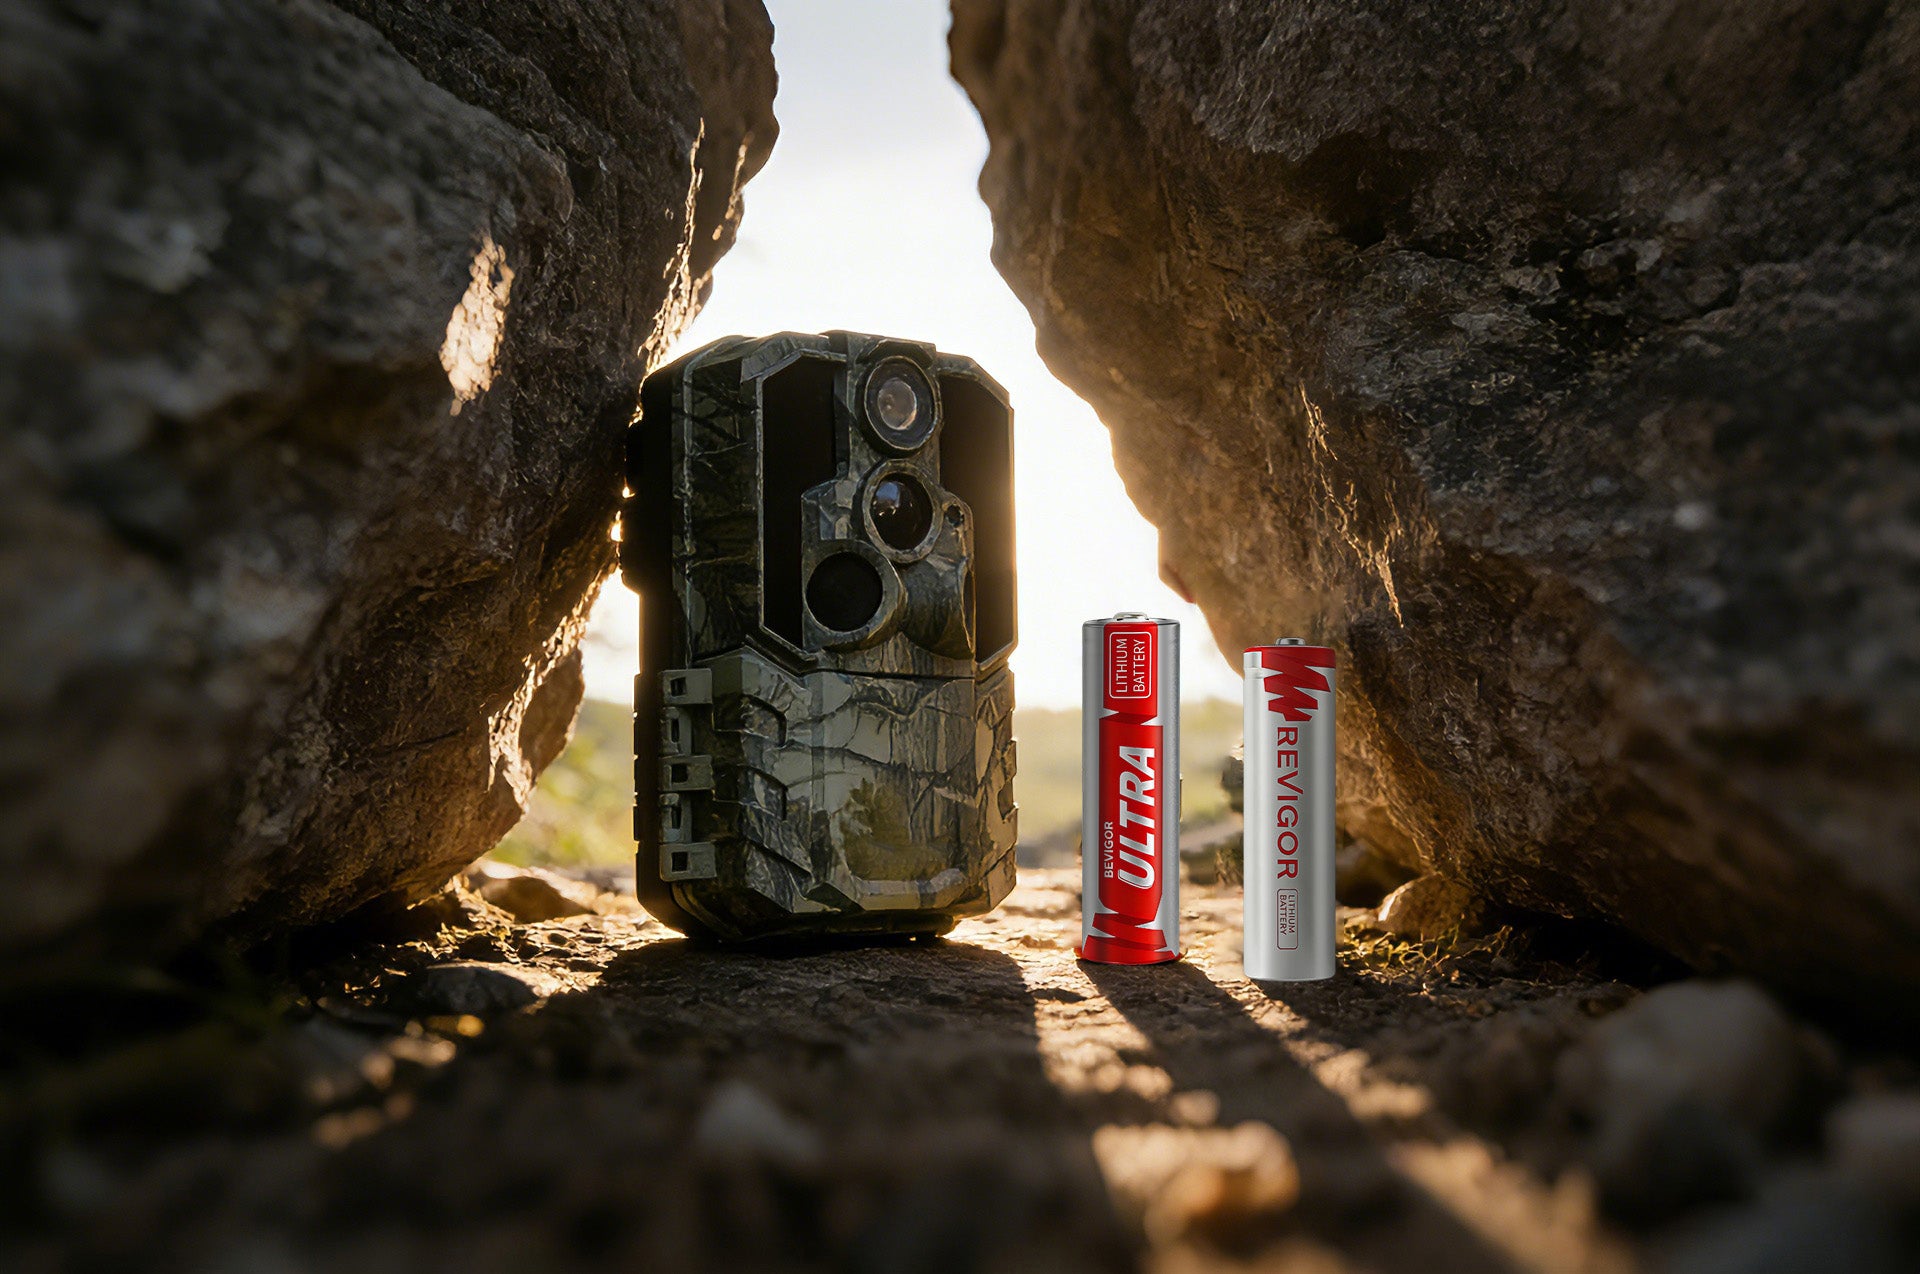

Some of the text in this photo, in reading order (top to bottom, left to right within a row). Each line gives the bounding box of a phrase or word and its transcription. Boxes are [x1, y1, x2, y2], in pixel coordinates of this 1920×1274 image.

[1115, 638, 1128, 693] LITHIUM
[1133, 639, 1146, 693] BATTERY
[1117, 745, 1156, 890] ULTRA
[1103, 821, 1114, 879] BEVIGOR
[1278, 894, 1287, 936] BATTERY
[1287, 894, 1297, 934] LITHIUM
